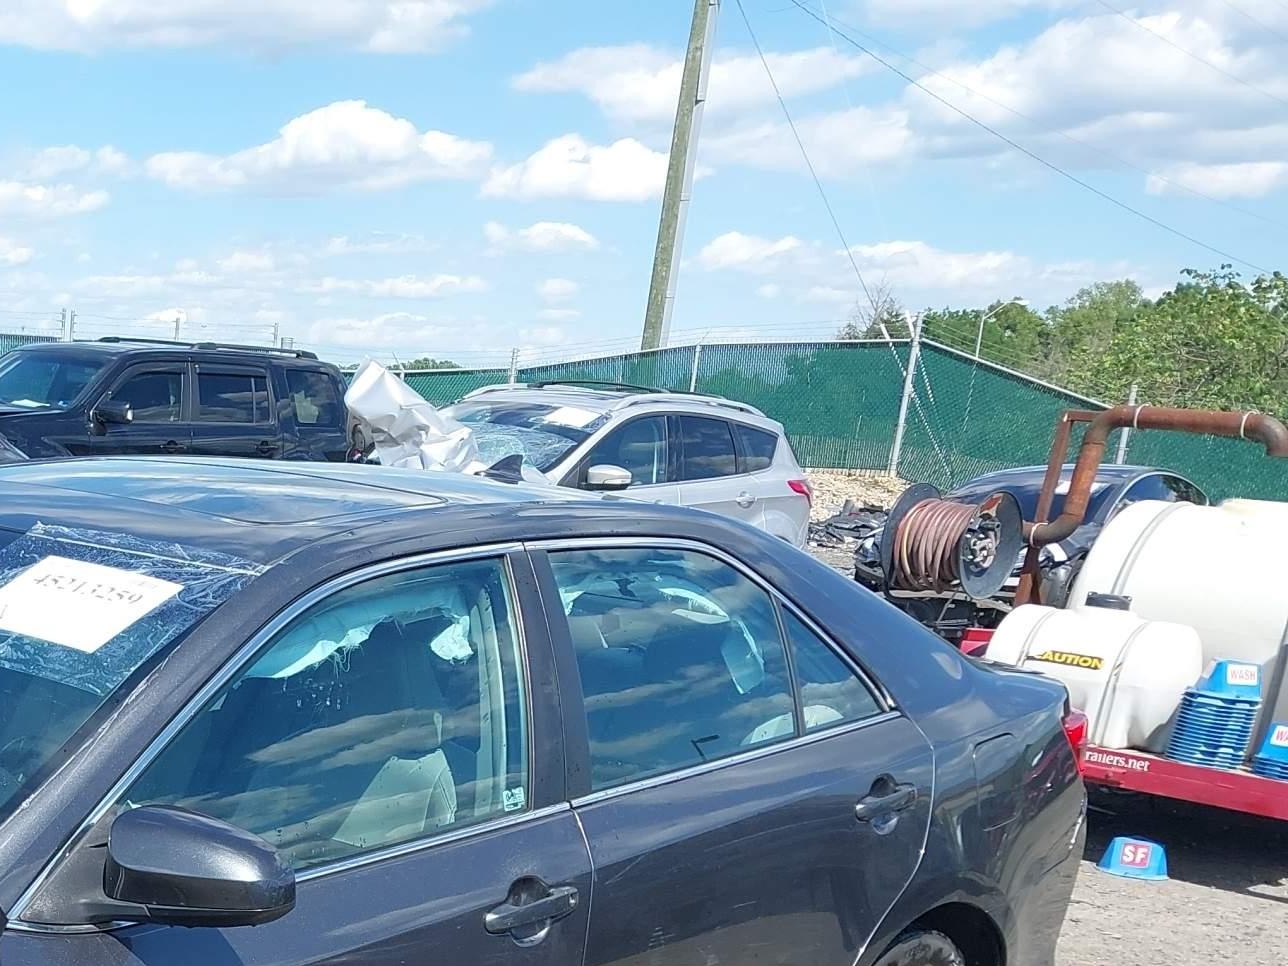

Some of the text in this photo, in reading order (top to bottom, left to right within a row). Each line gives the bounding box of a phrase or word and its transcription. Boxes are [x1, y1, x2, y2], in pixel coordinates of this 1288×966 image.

[1033, 650, 1104, 669] AUTION
[1229, 668, 1256, 681] WASH
[1085, 751, 1151, 772] railers.net
[1122, 844, 1149, 864] SF
